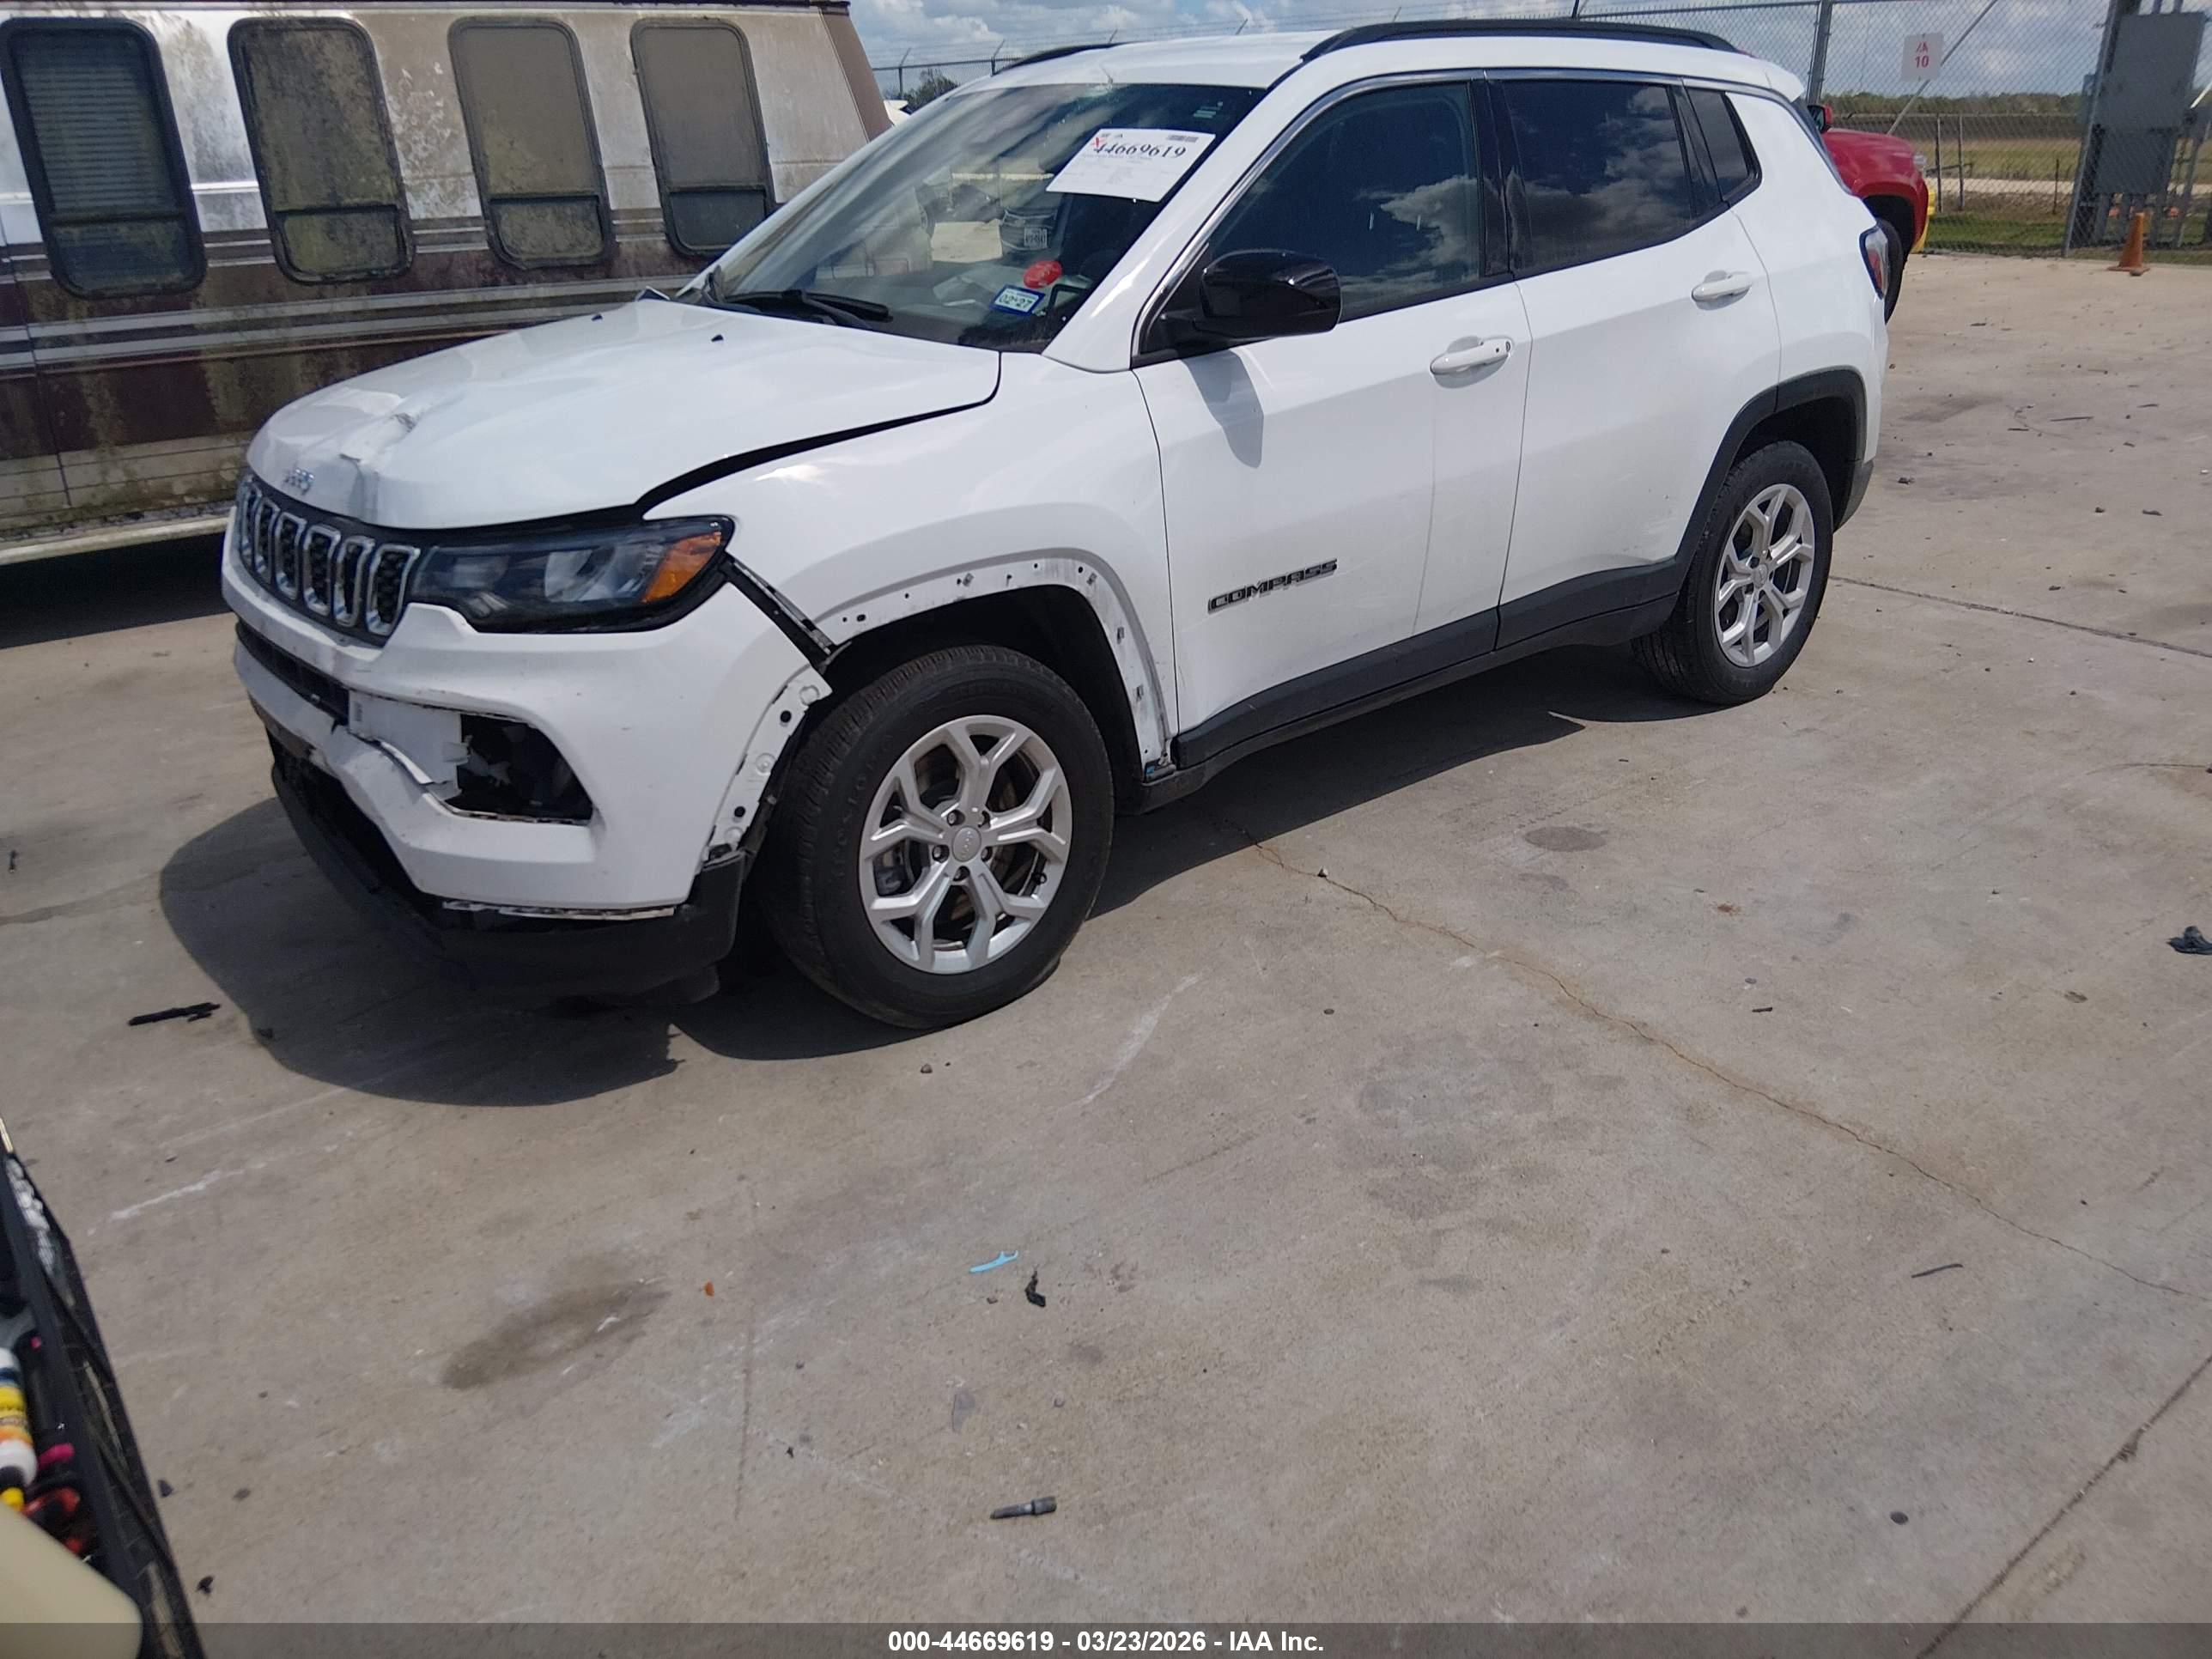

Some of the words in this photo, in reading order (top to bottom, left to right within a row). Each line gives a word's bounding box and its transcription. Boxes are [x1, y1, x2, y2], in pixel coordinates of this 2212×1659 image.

[1915, 55, 1929, 69] 10
[1093, 143, 1187, 159] 44669619
[1208, 558, 1338, 613] COMPASS
